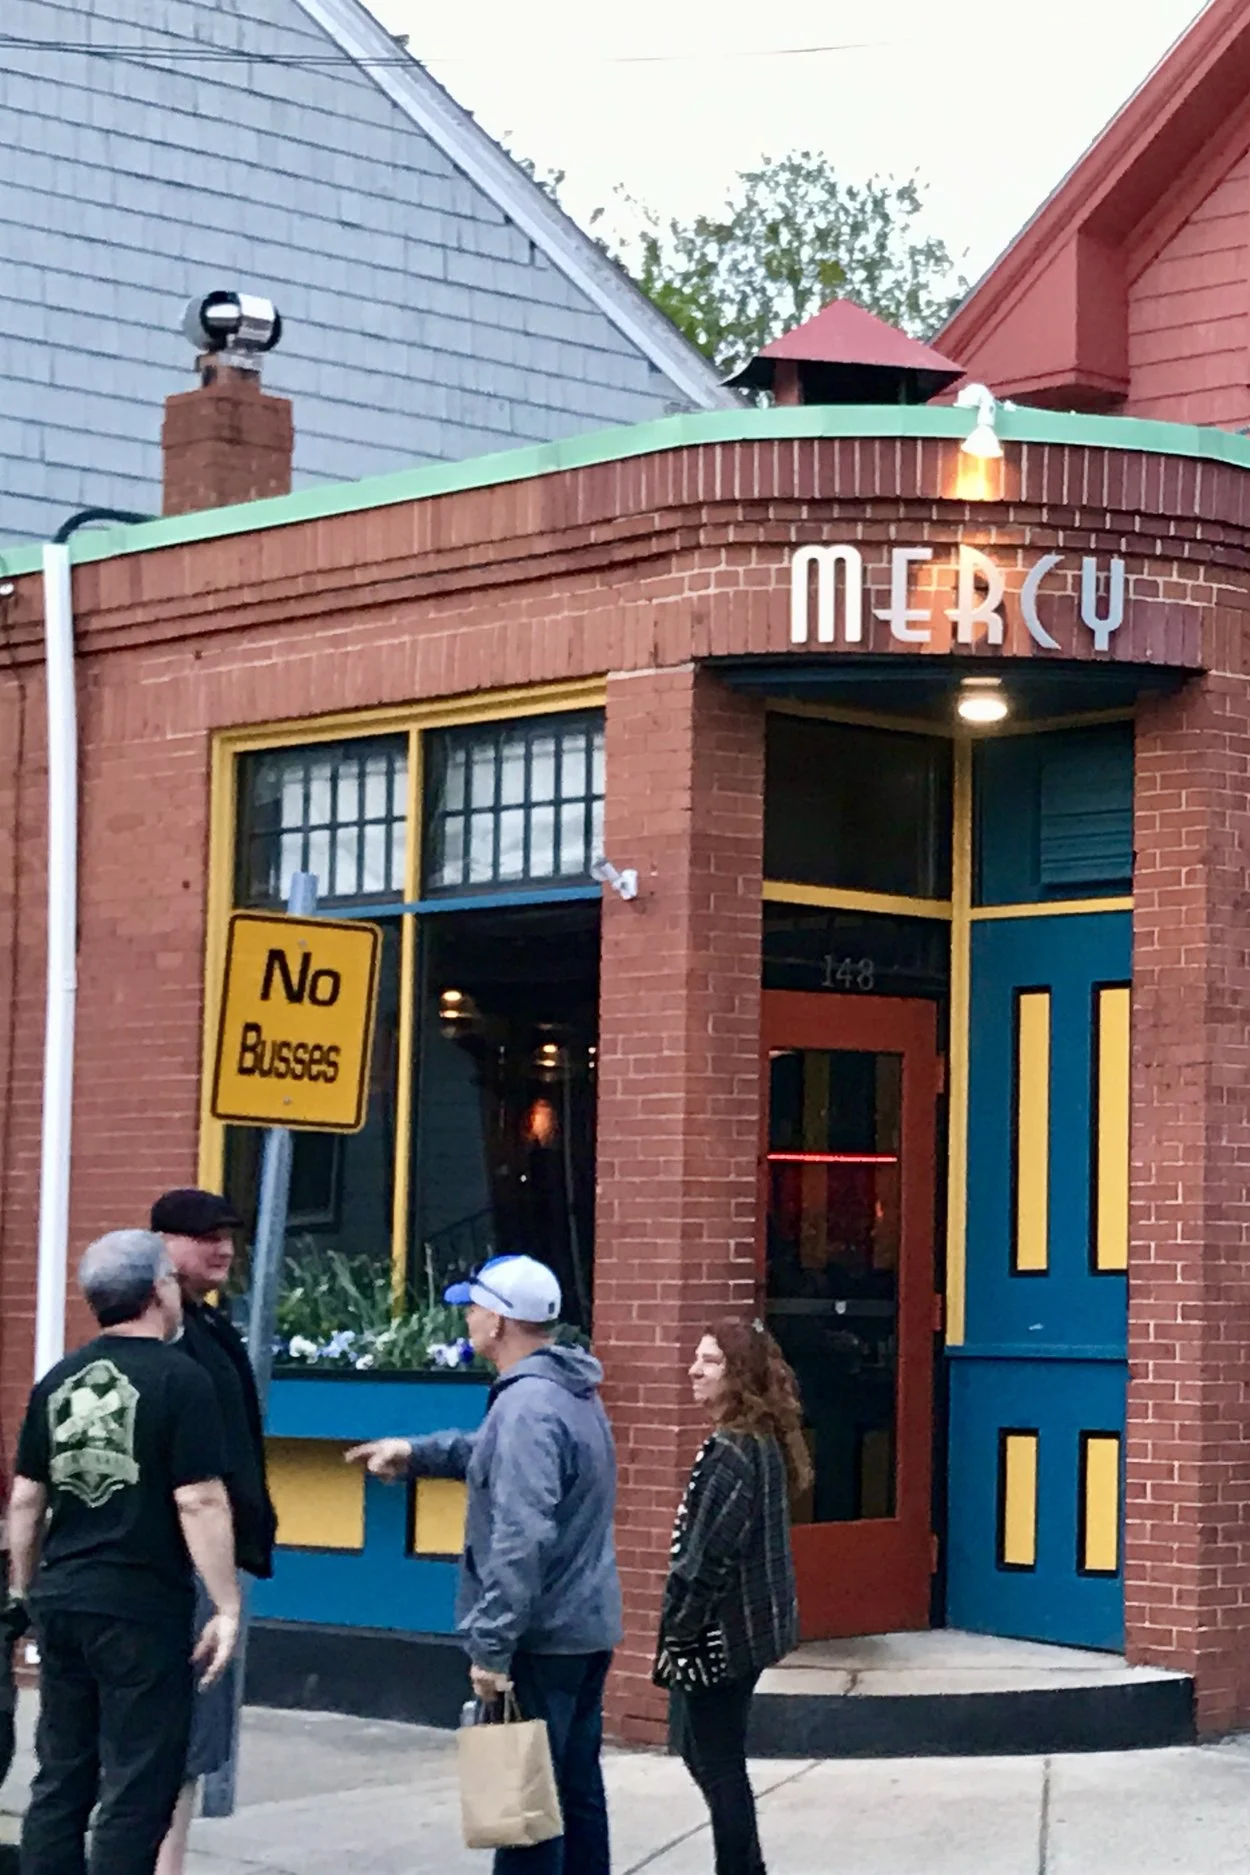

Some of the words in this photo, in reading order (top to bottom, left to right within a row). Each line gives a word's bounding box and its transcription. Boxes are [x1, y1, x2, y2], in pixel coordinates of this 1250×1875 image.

[791, 544, 1125, 650] MERCY
[260, 948, 341, 1007] No
[821, 954, 875, 991] 148
[237, 1022, 341, 1083] Busses
